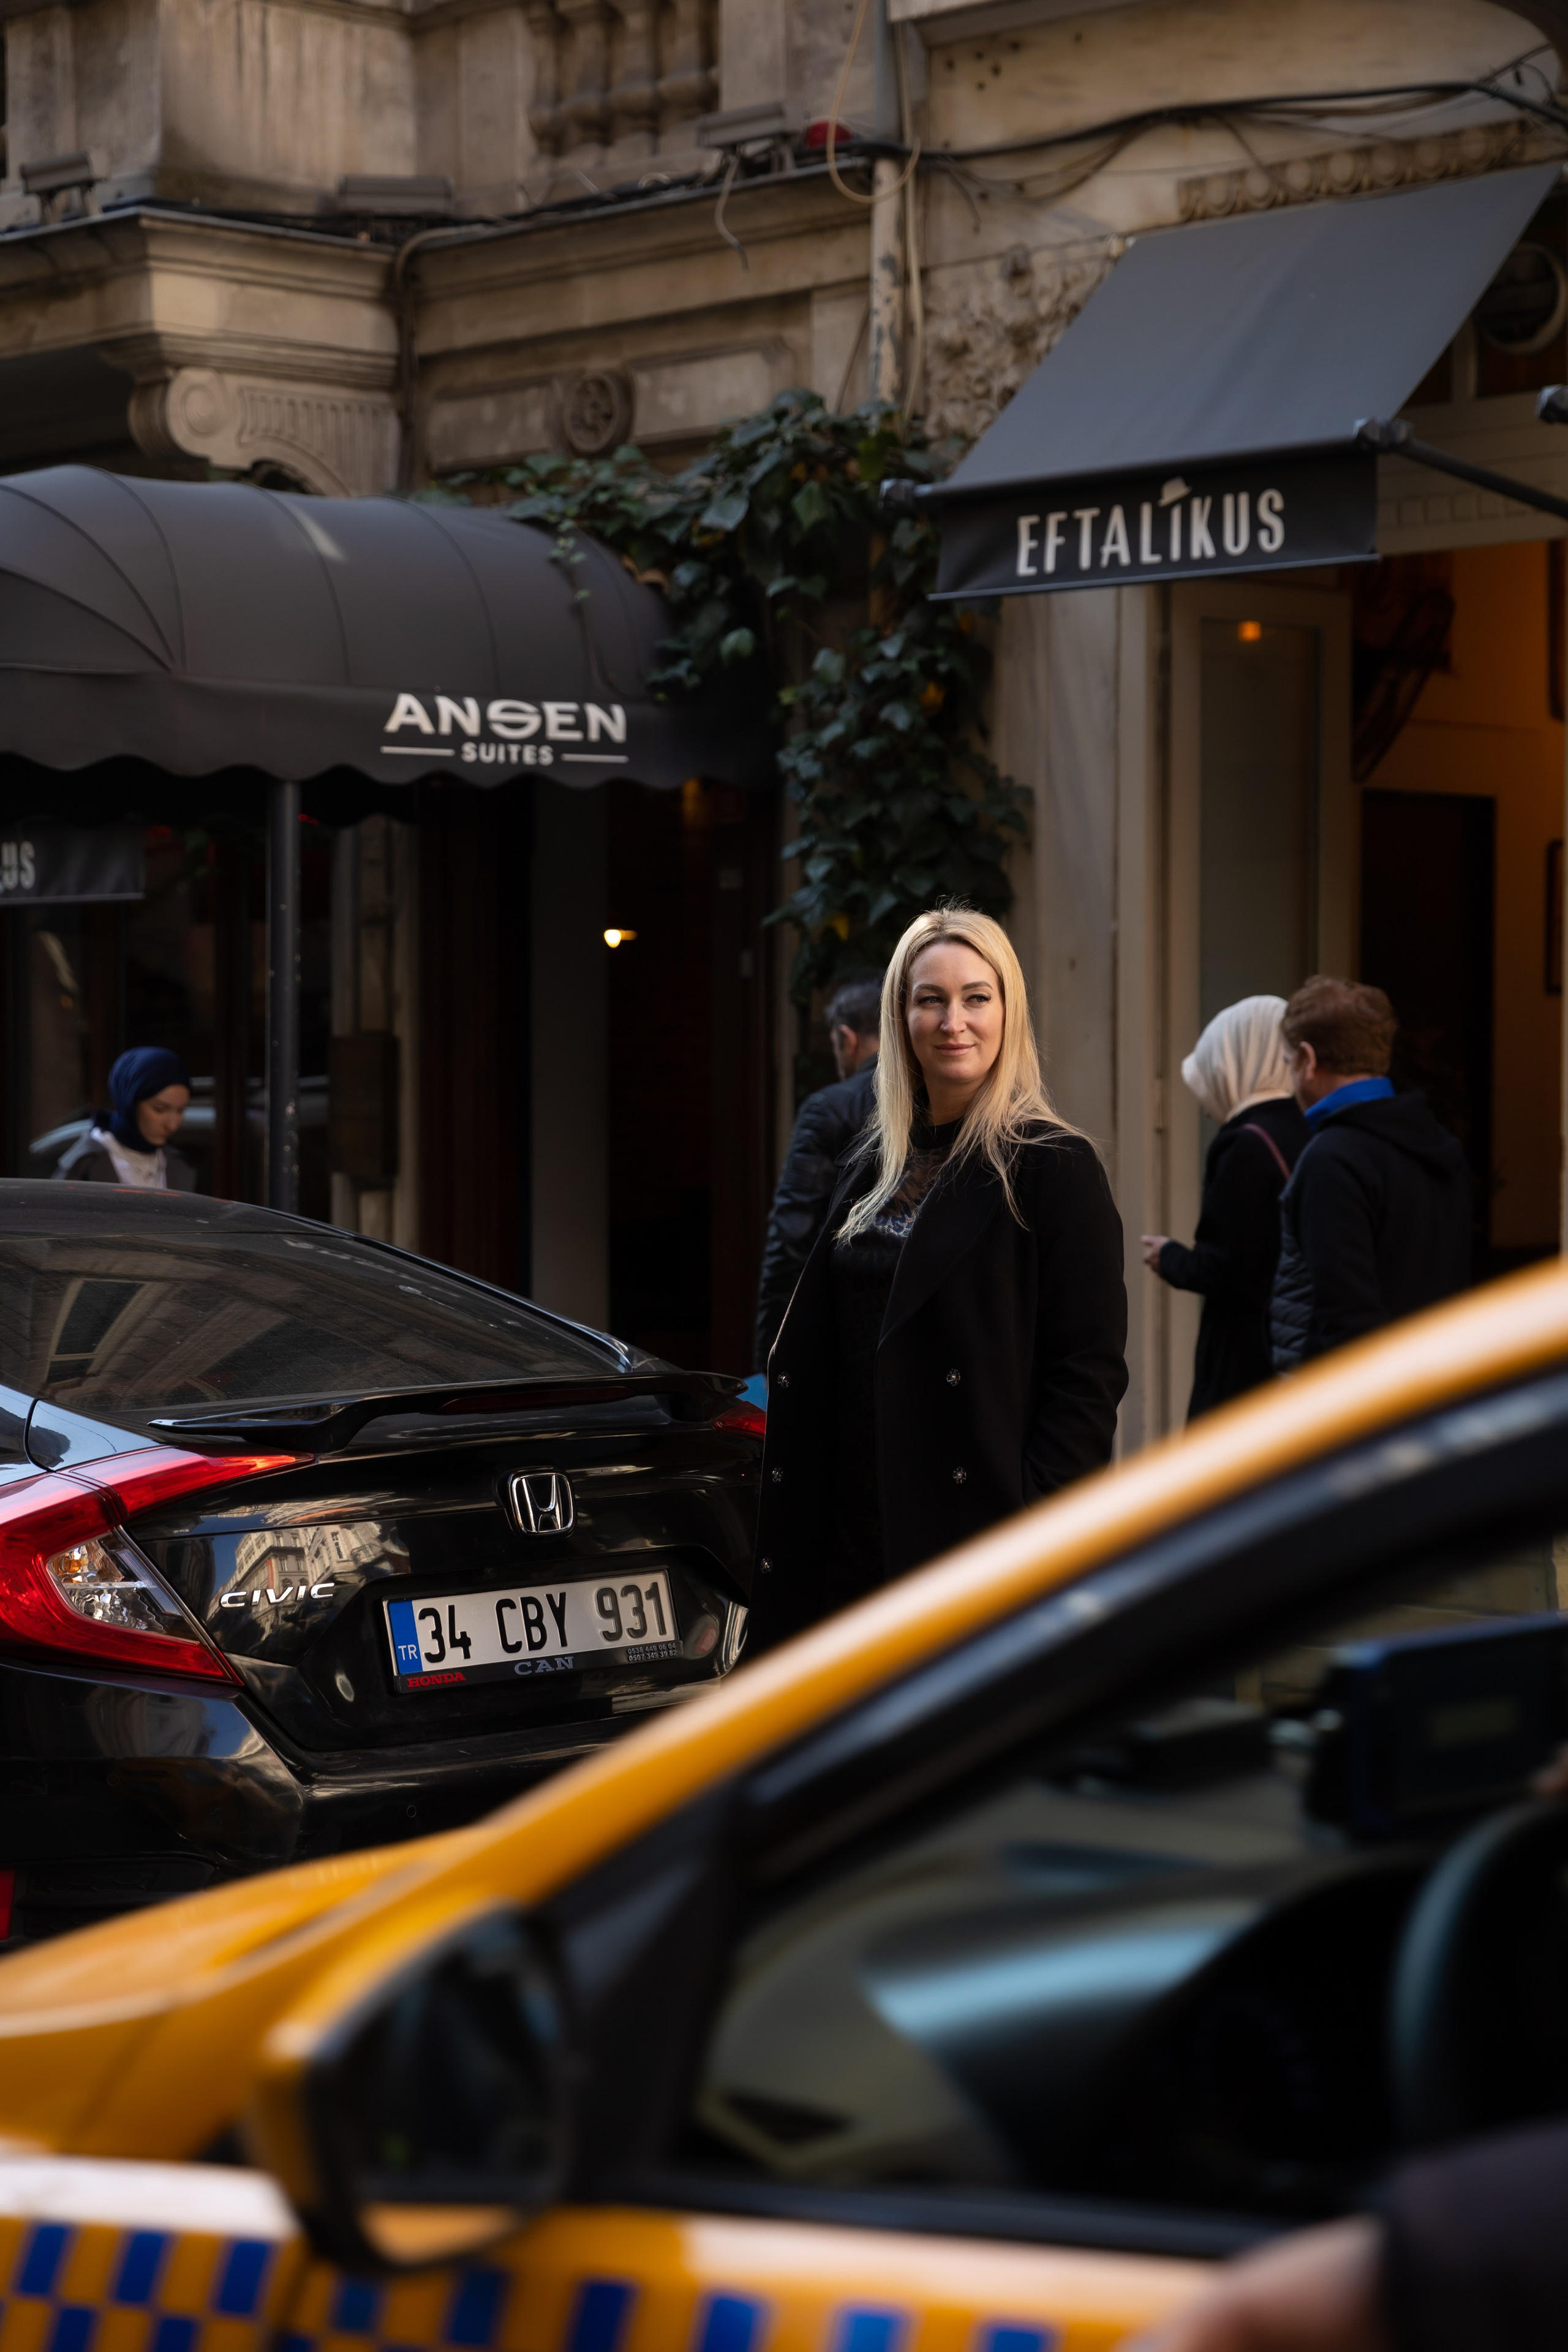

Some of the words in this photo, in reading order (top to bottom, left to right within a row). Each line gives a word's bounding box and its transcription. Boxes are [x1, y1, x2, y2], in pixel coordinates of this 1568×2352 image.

[383, 693, 627, 743] ANSEN
[461, 741, 554, 766] SUITES
[221, 1583, 335, 1608] CIVIC
[418, 1604, 472, 1664] 34
[496, 1591, 567, 1654] CBY
[596, 1581, 667, 1642] 931
[398, 1644, 418, 1661] TR
[514, 1656, 574, 1675] CAN
[407, 1671, 466, 1688] HONDA
